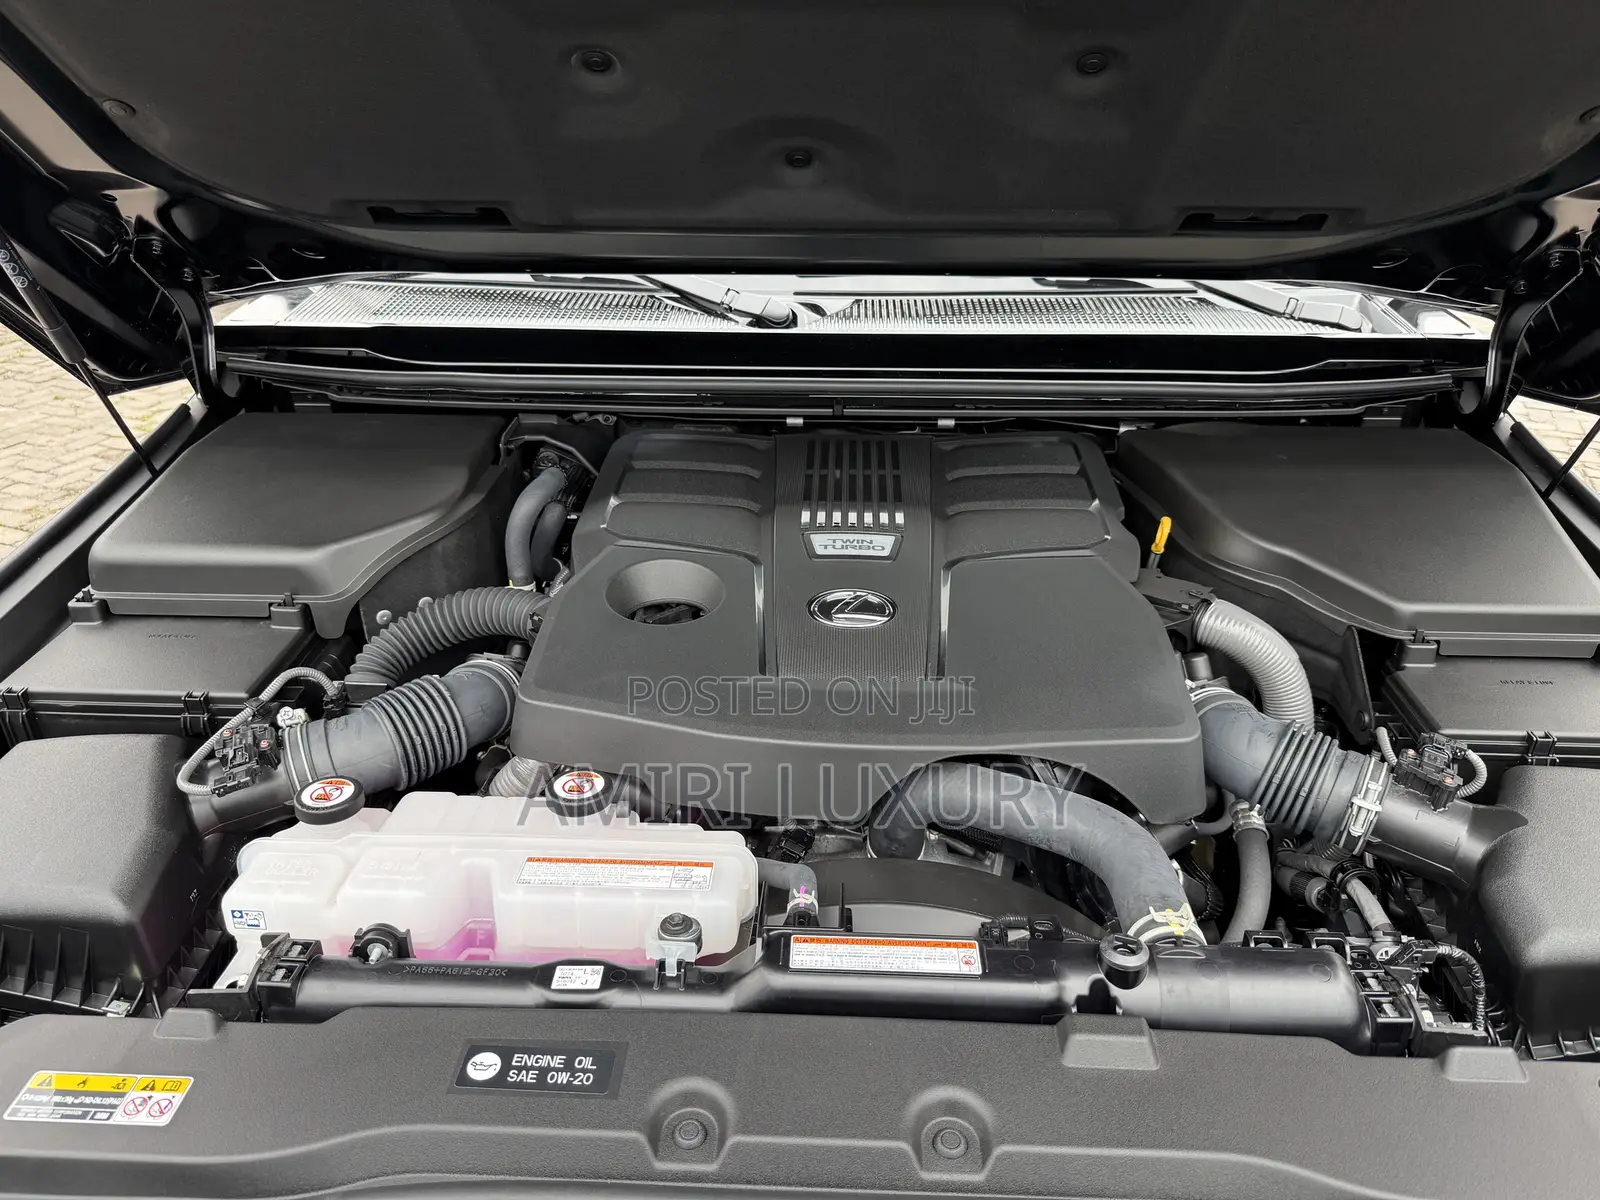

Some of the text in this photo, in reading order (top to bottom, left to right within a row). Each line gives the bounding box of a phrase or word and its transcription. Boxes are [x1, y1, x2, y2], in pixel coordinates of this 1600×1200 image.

[818, 544, 886, 552] TURBO
[512, 1053, 597, 1069] ENGINE OIL
[507, 1069, 594, 1085] SAE 0W-20
